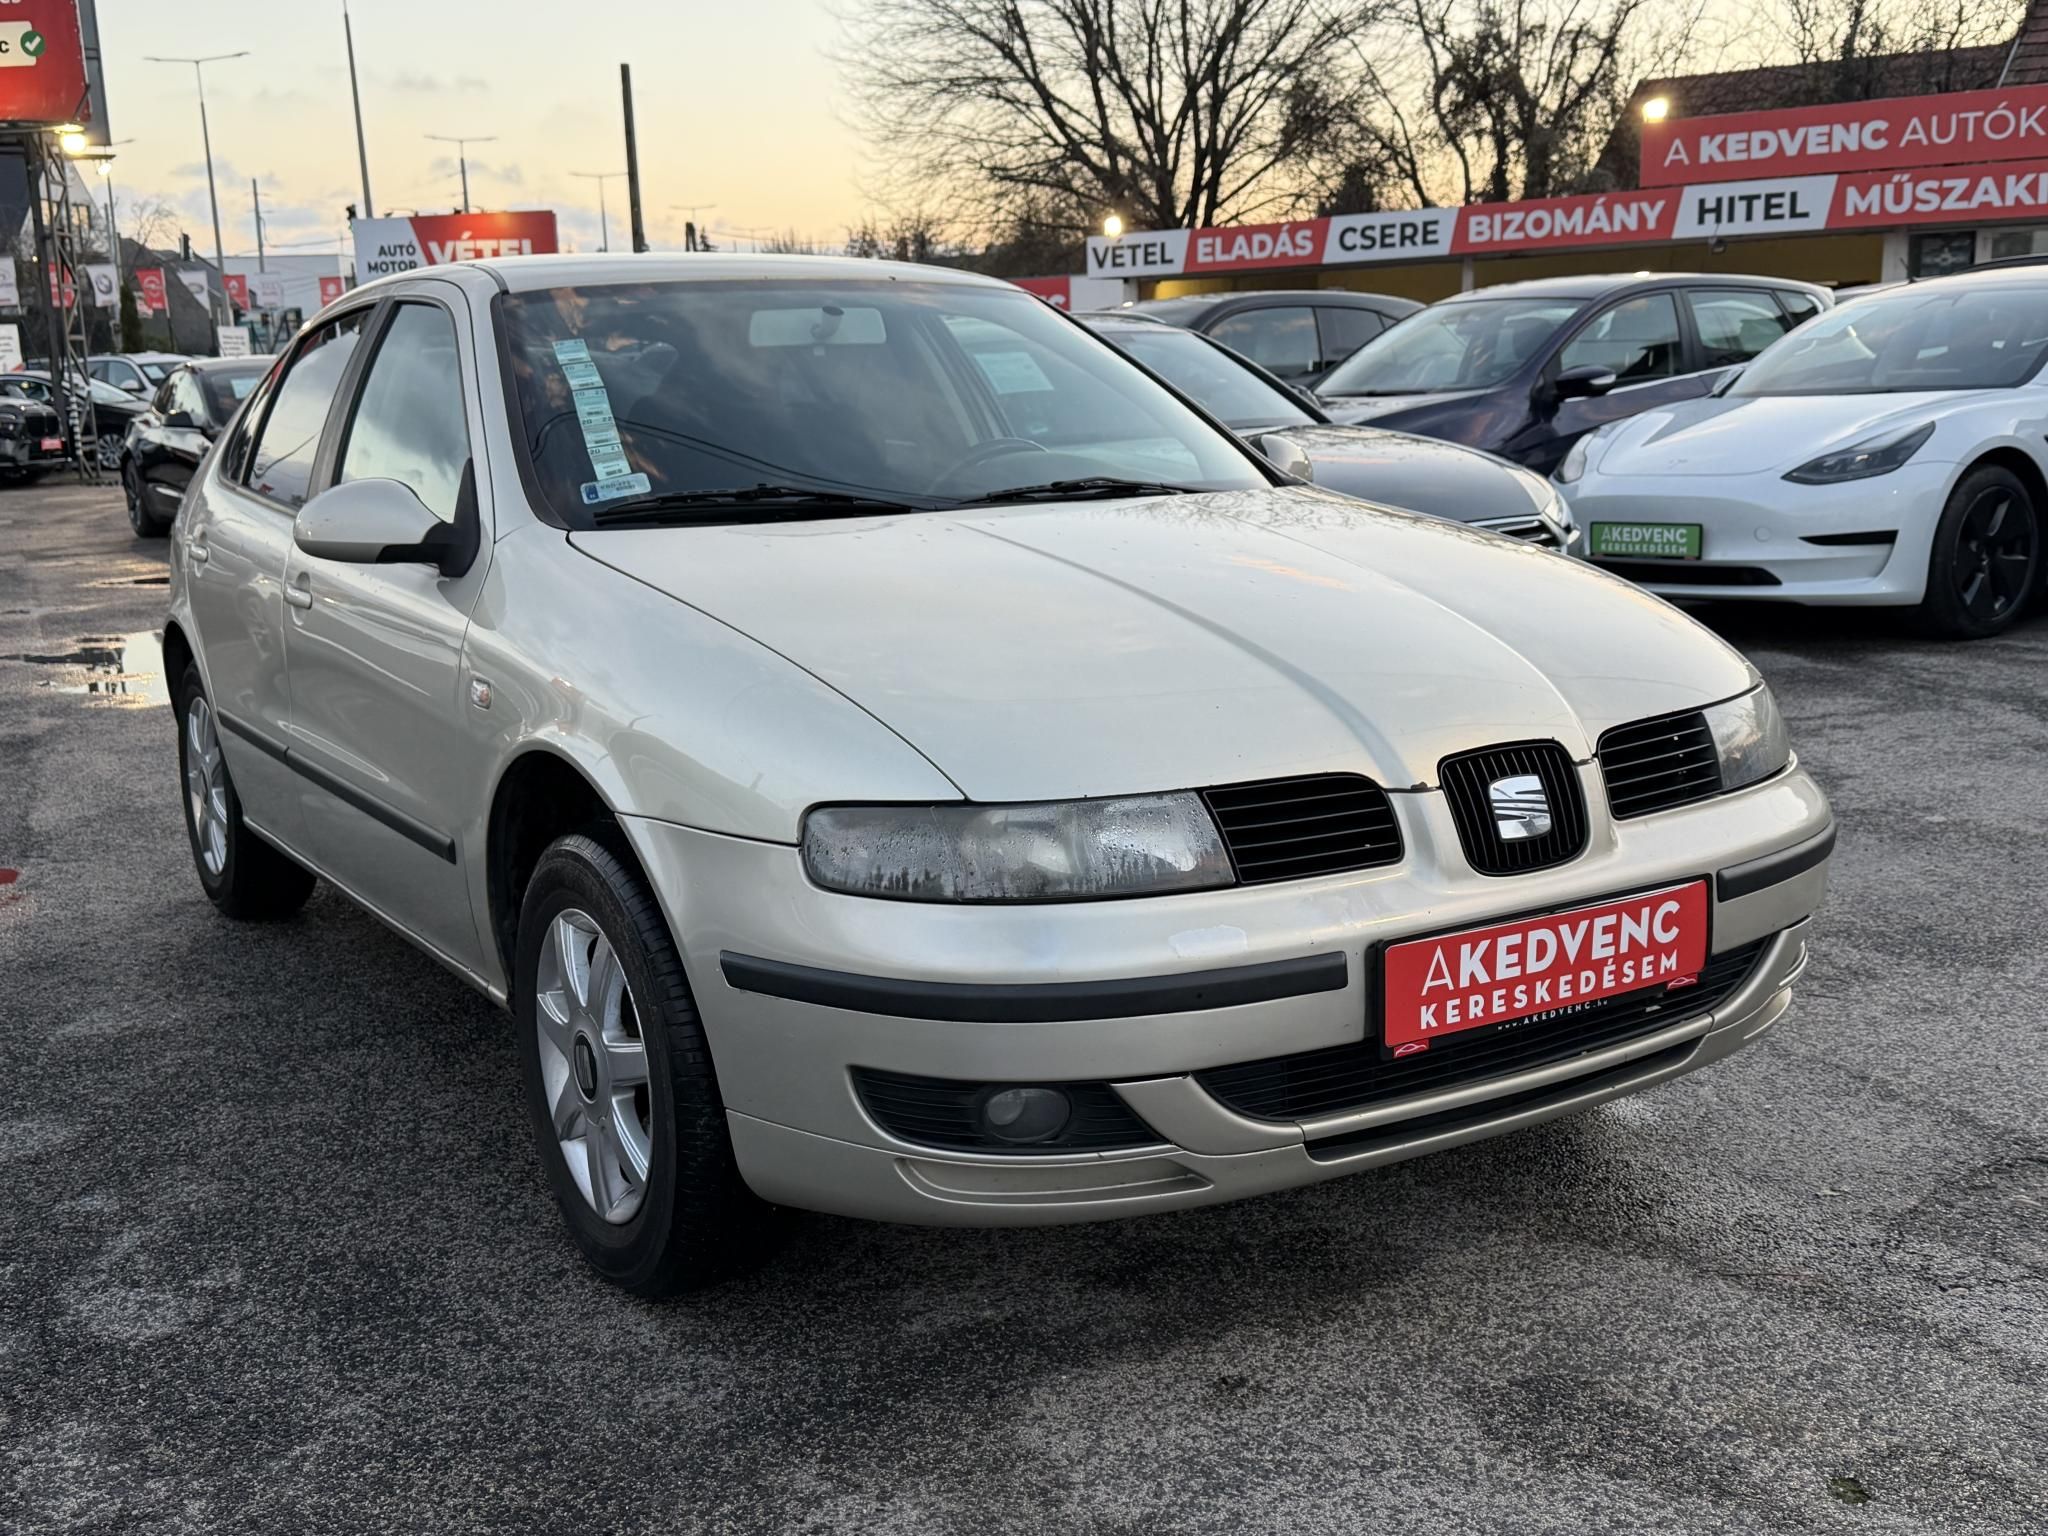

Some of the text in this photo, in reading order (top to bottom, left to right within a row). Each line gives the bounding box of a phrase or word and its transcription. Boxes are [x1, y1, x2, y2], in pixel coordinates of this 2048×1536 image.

[1664, 101, 2047, 168] A KEDVENC AUTÓK
[1092, 172, 2048, 269] VÉTEL ELADÁS CSERE BIZOMÁNY HITEL MŰSZAKI
[367, 260, 417, 274] MOTOR
[378, 241, 416, 258] AUTÓ
[1420, 949, 1679, 1030] KERESKEDÉSEM
[1498, 999, 1609, 1031] www.AKEDVENC.hu
